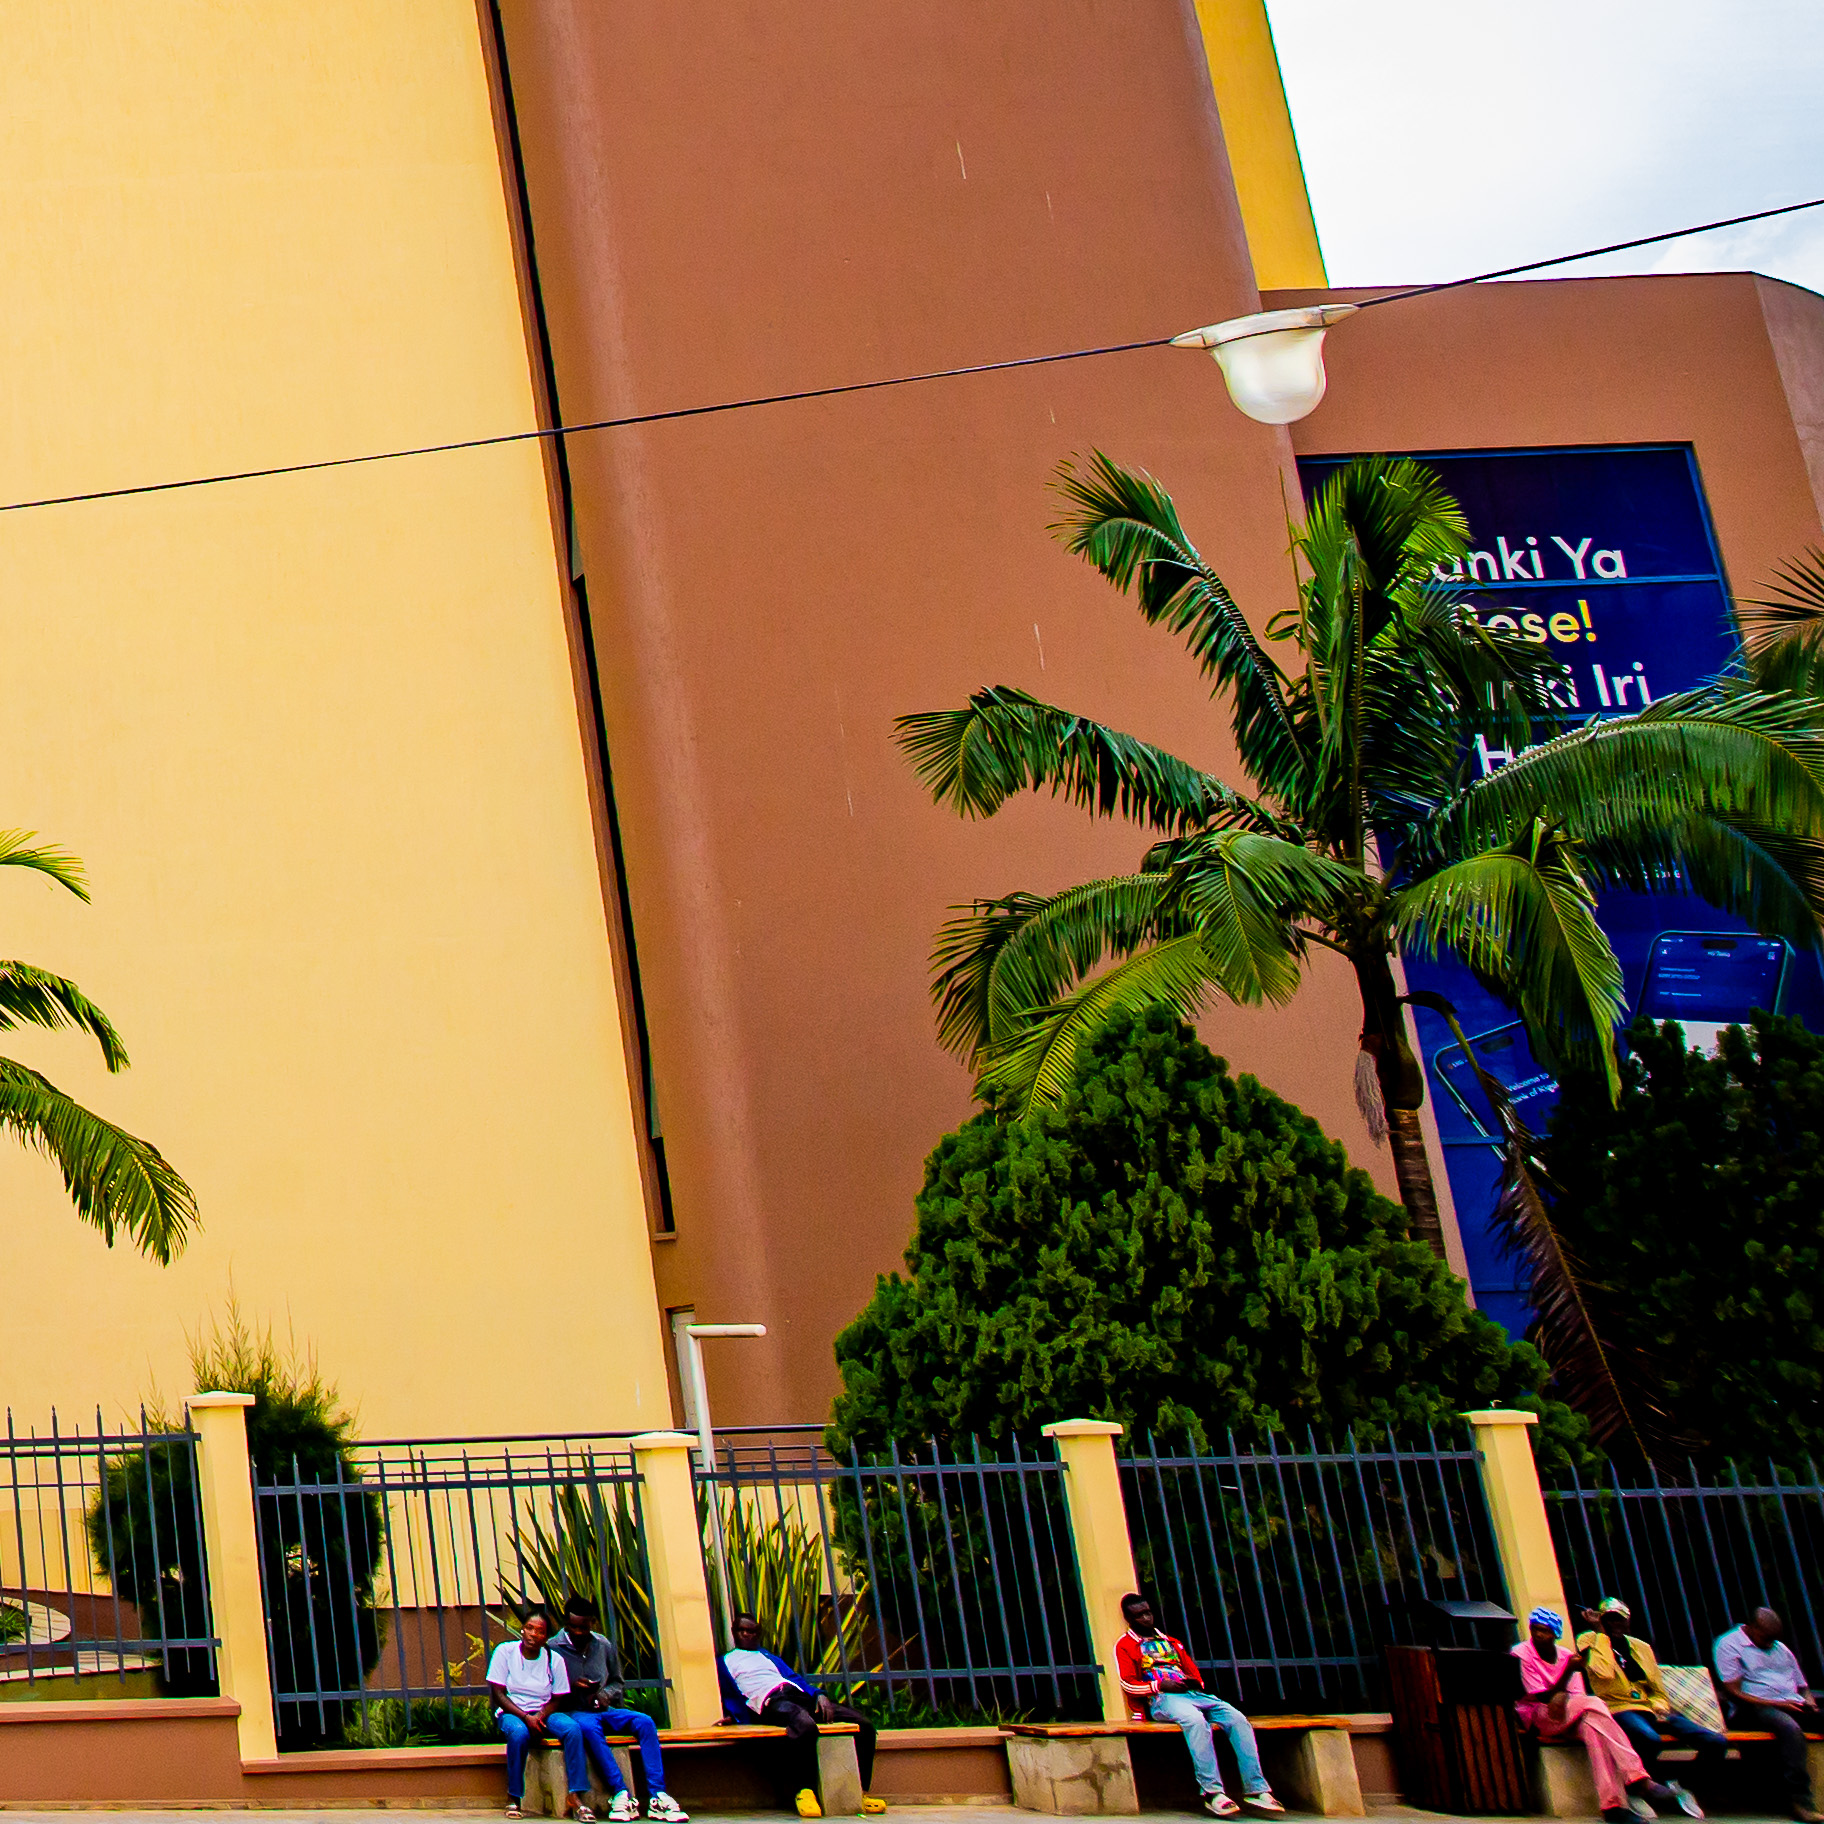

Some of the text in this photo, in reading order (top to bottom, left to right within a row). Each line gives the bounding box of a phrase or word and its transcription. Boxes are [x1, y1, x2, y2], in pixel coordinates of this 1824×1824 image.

[1430, 536, 1628, 582] anki Ya
[1592, 661, 1651, 707] Iri
